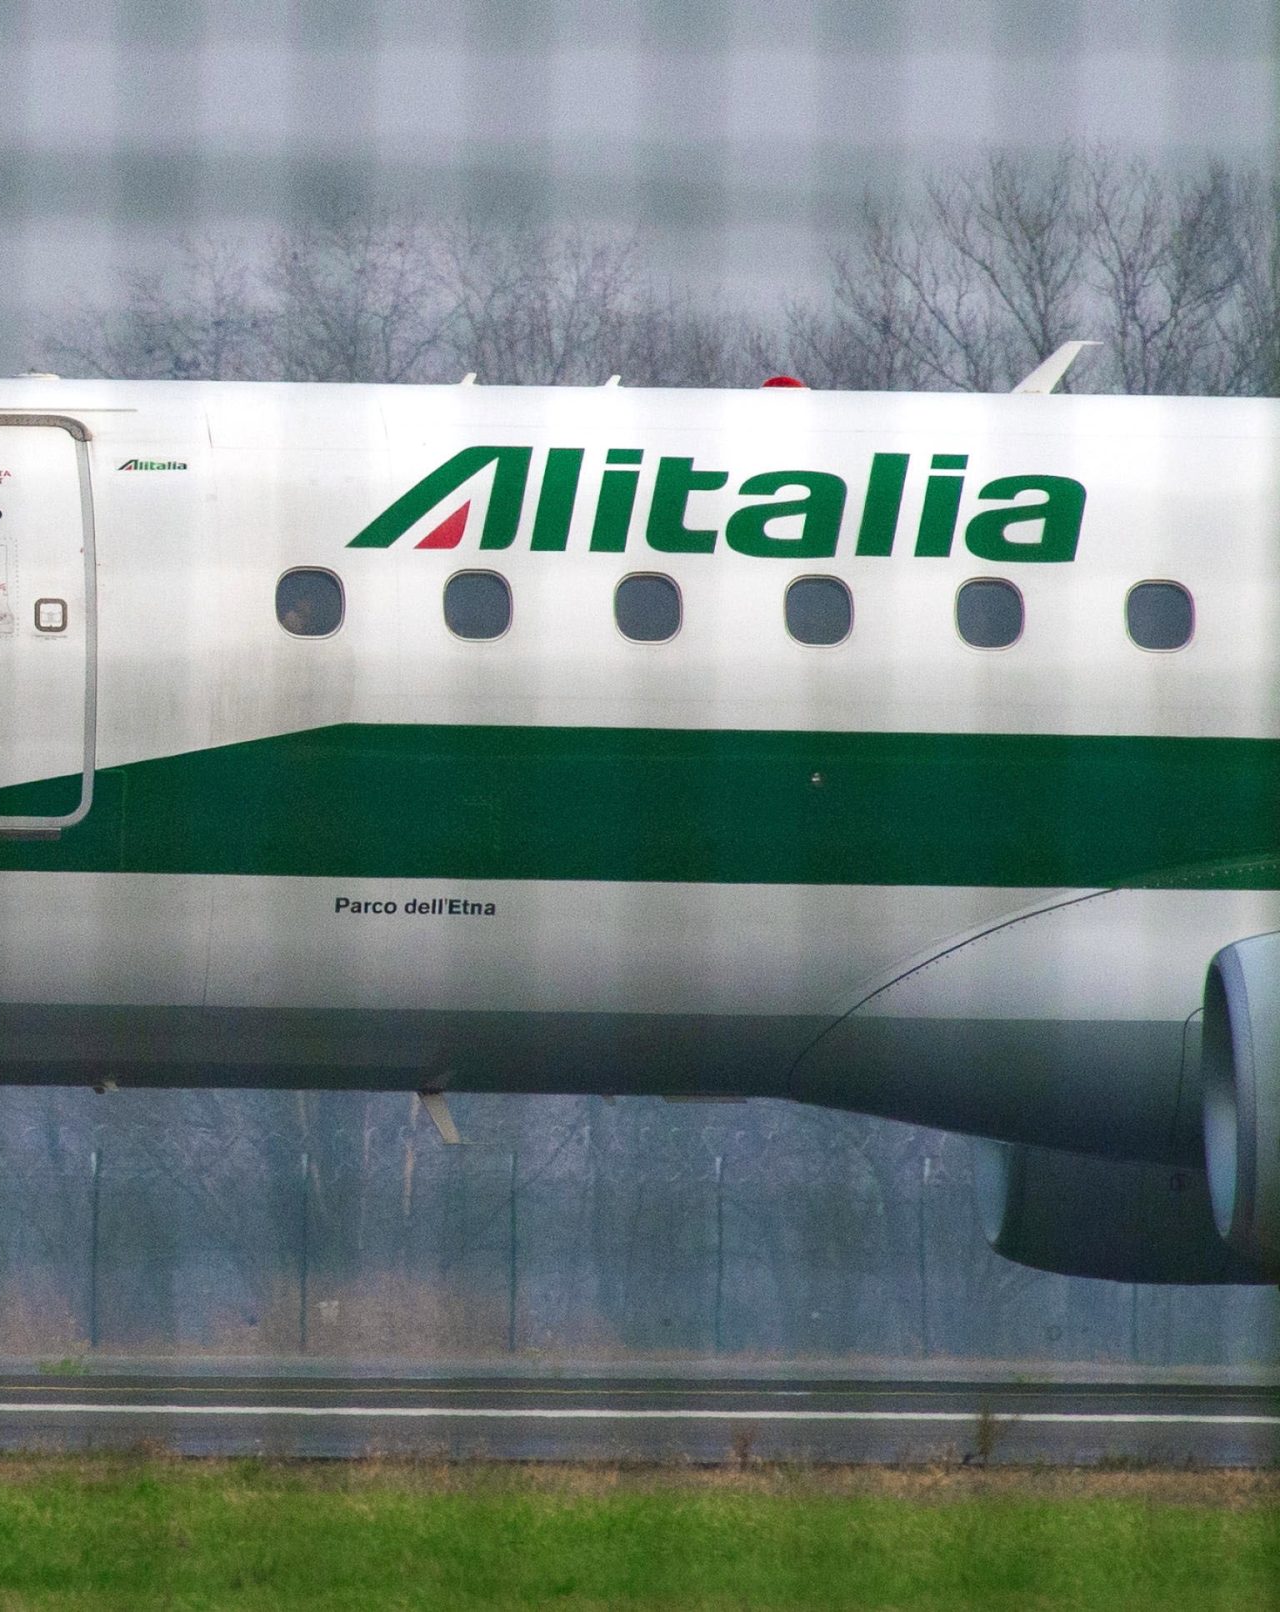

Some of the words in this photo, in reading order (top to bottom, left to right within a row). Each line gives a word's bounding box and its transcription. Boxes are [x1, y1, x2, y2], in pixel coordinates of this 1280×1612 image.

[118, 459, 187, 471] Alitalia
[344, 445, 1088, 563] Alitalia
[334, 897, 398, 914] Parco
[404, 898, 496, 915] dell'Etna
